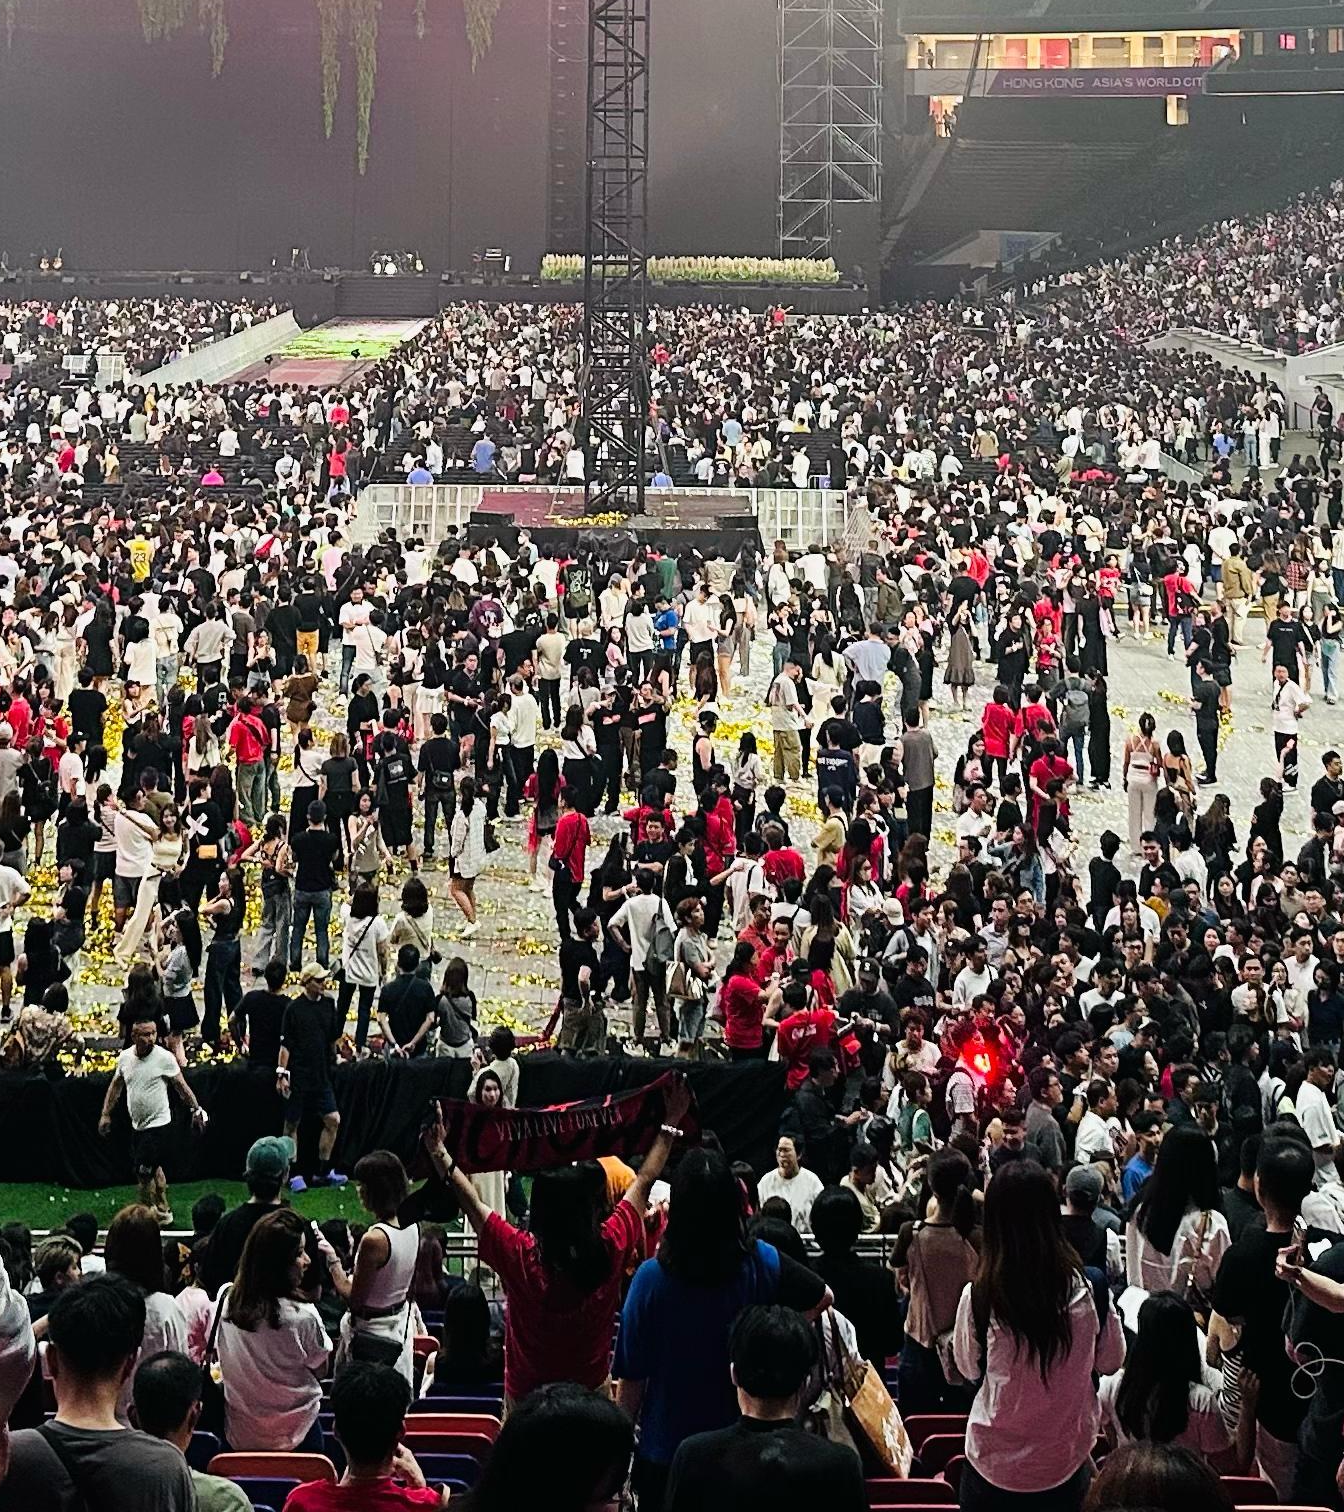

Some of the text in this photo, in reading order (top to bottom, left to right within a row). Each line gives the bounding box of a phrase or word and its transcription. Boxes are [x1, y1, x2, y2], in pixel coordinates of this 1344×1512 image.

[1002, 76, 1203, 89] HONG KONG ASIA'S WORLD CIT
